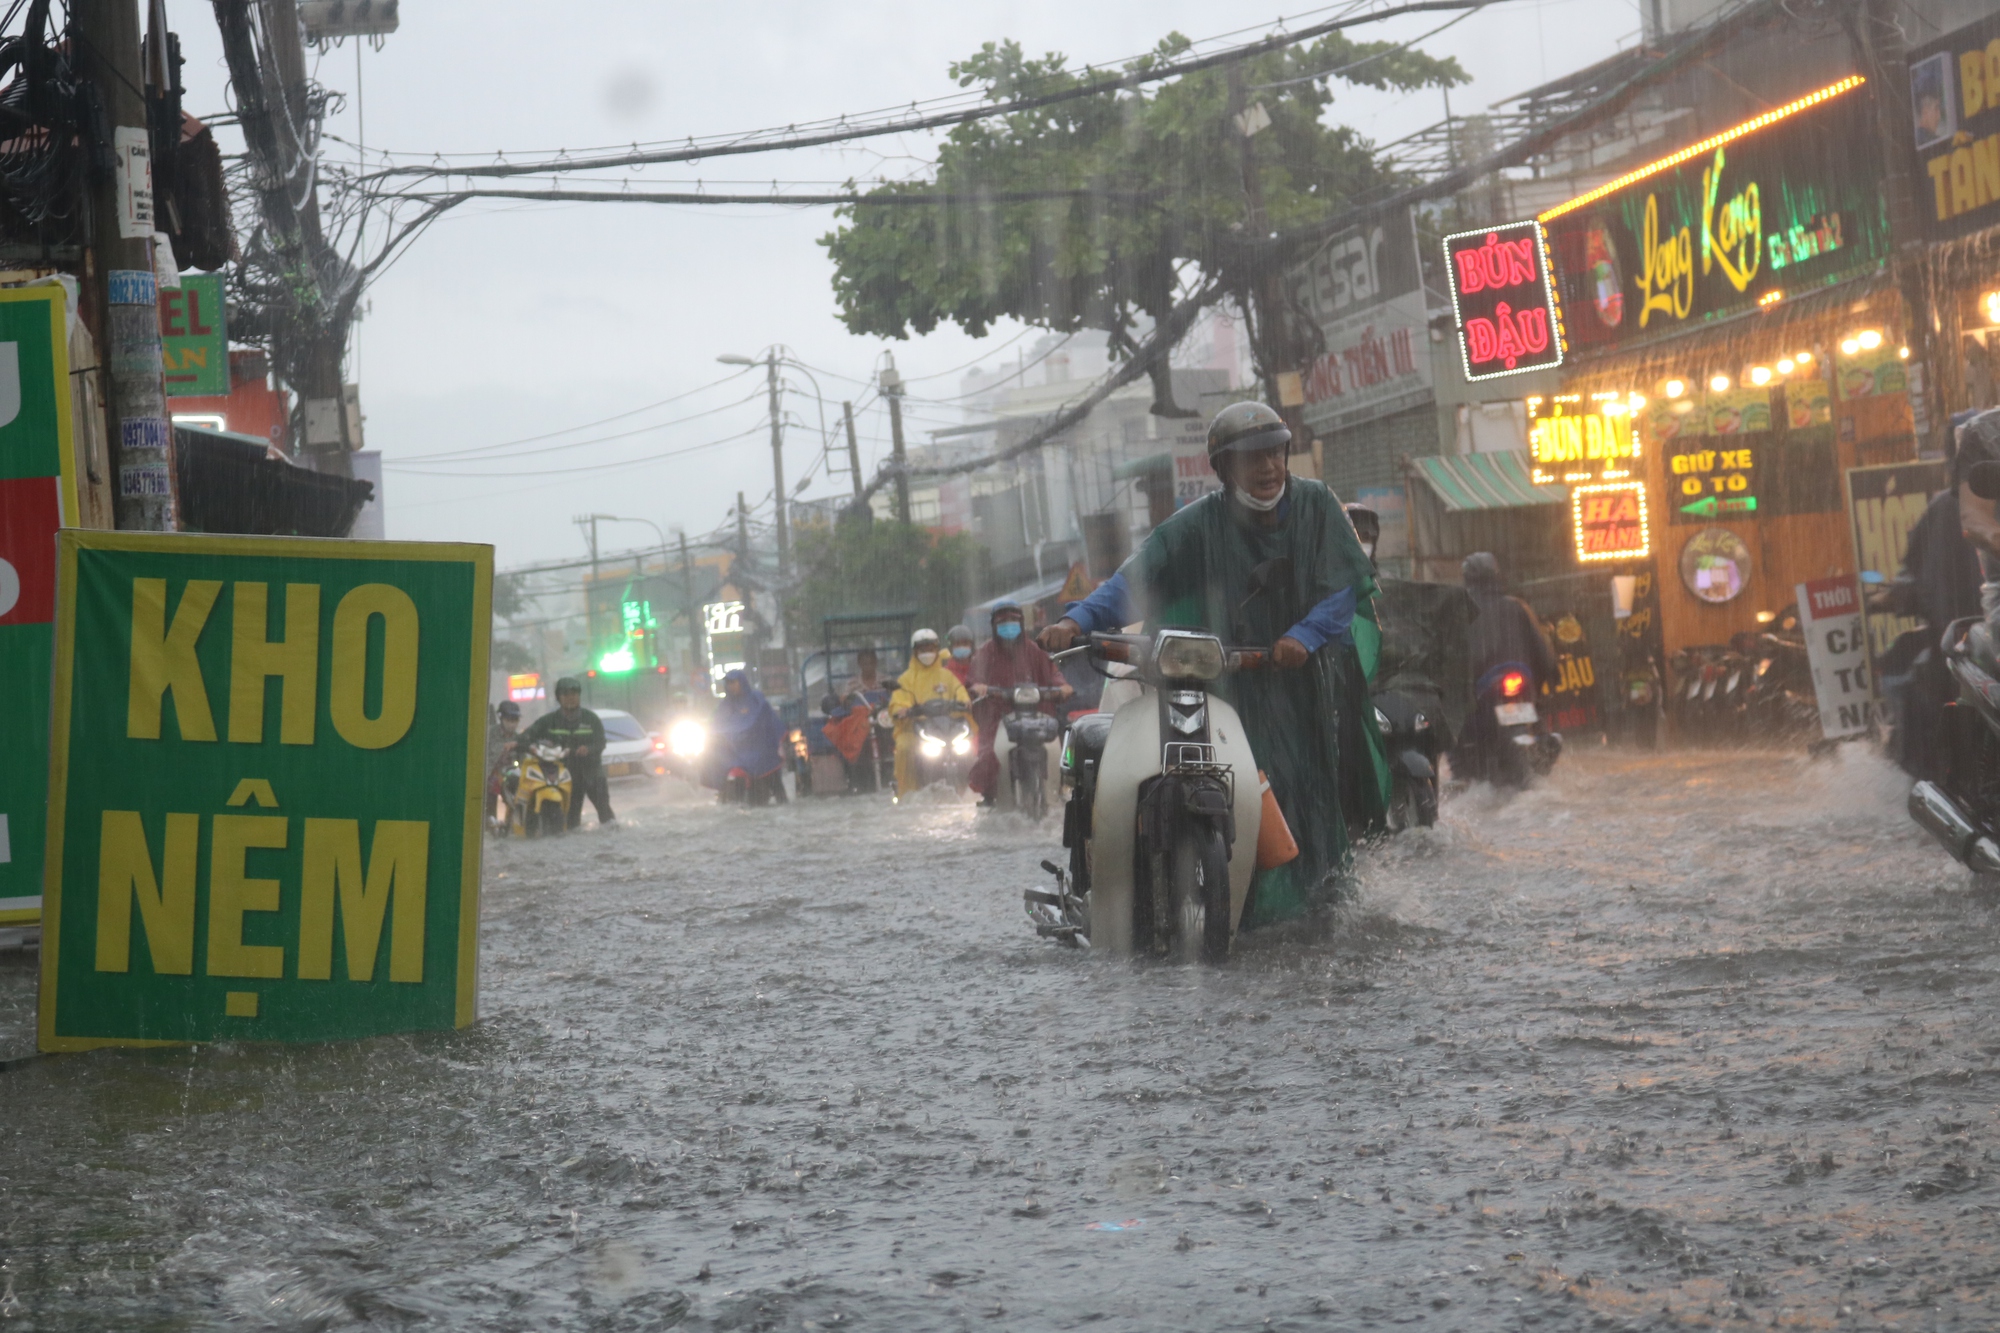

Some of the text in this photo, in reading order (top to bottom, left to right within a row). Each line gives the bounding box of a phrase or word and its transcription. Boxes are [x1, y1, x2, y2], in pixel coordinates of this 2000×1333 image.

[1455, 231, 1536, 294] BÚN
[1466, 301, 1548, 370] ĐẬU
[1720, 448, 1753, 470] XE
[126, 576, 420, 750] KHO
[95, 778, 430, 1018] NỆM
